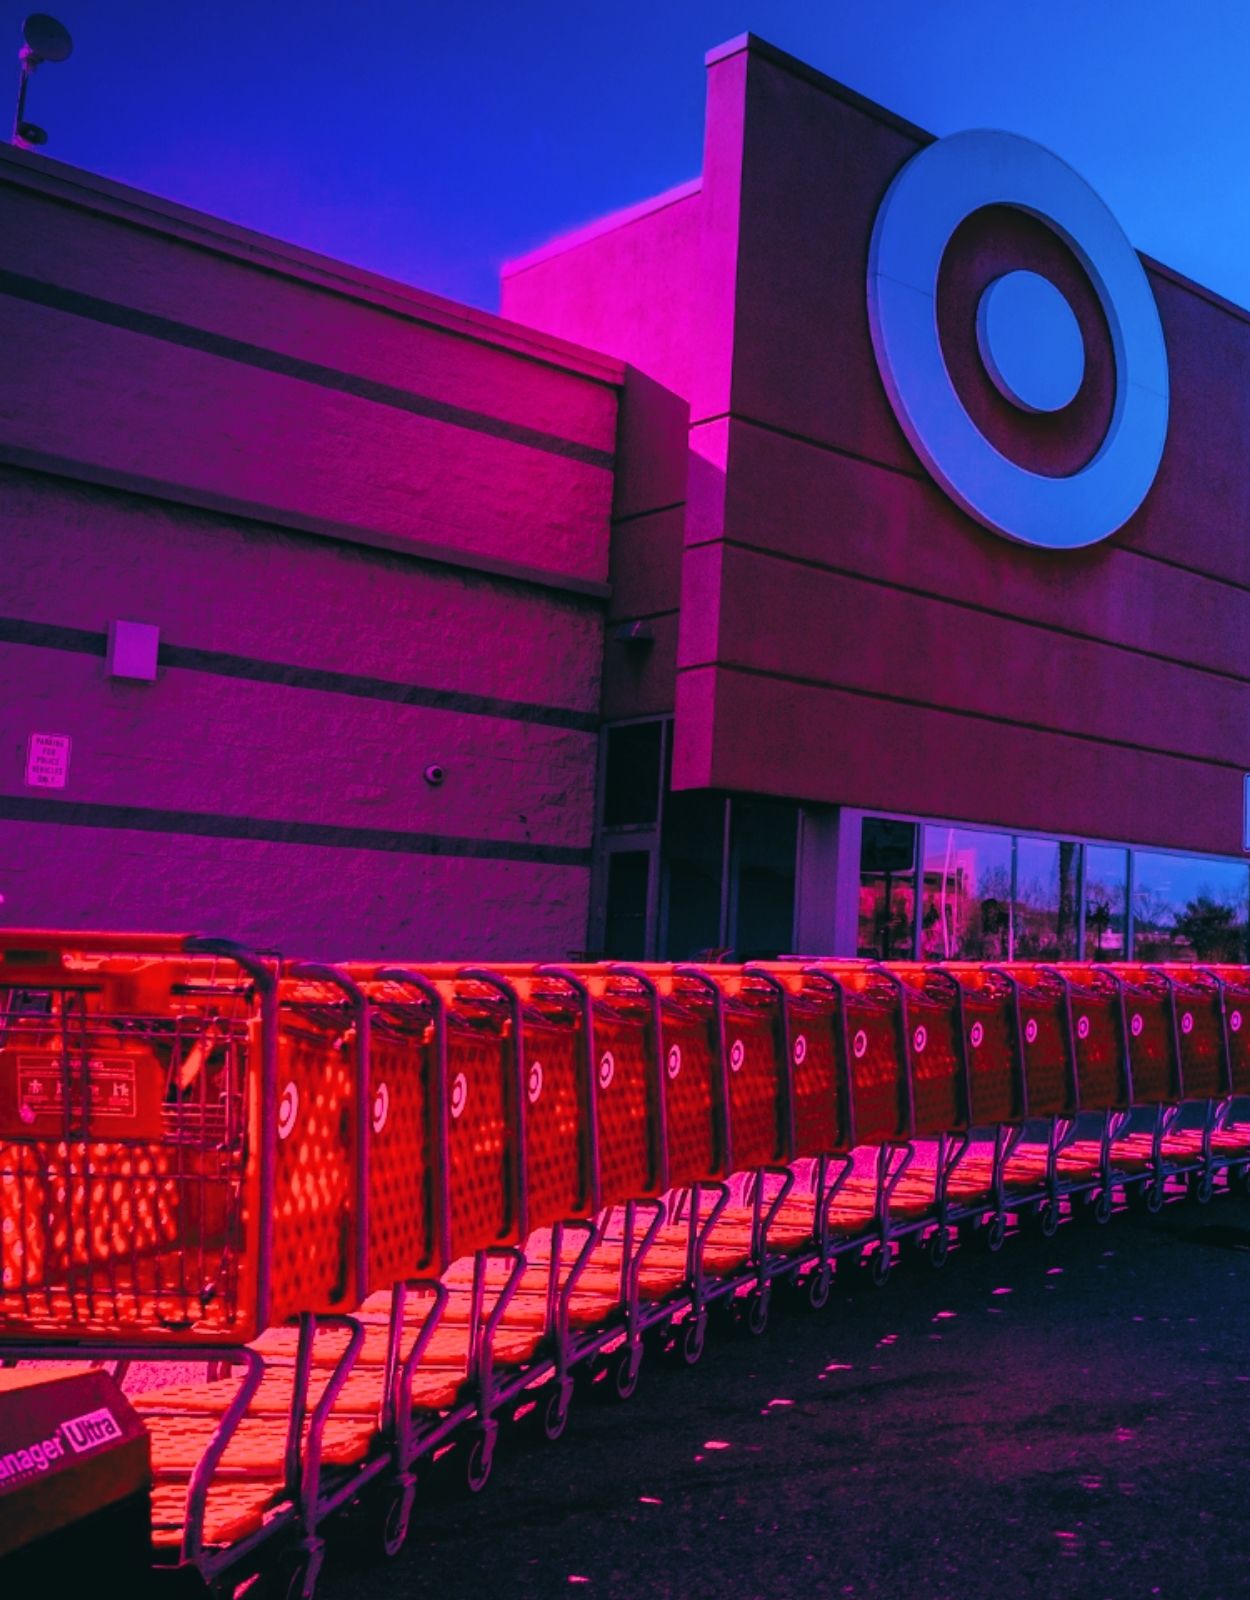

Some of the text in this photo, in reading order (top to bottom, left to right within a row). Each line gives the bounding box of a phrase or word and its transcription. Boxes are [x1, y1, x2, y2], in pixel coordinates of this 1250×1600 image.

[36, 737, 64, 747] PARKING
[42, 747, 56, 756] FOR
[65, 1418, 117, 1448] Ultra
